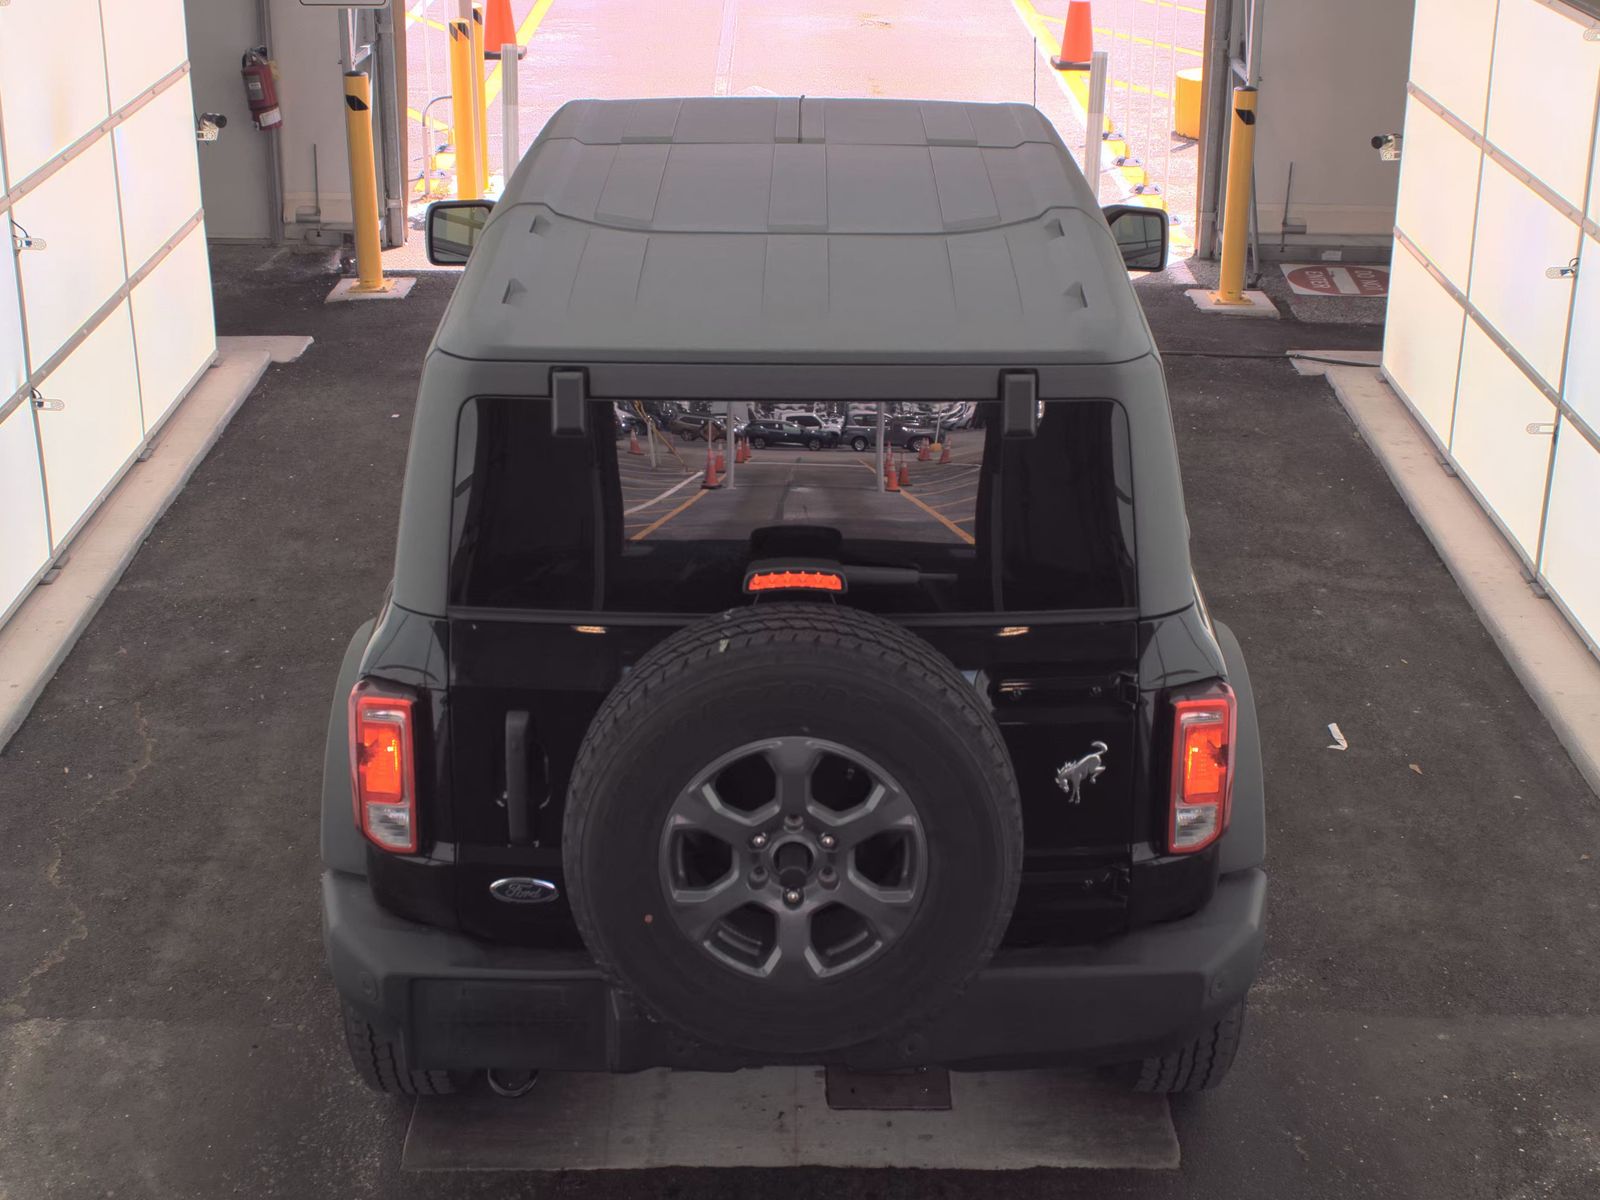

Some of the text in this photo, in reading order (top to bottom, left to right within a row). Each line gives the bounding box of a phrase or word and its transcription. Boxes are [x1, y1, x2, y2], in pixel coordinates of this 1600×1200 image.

[1305, 270, 1331, 289] ENTER
[1355, 270, 1384, 291] DO NOT
[505, 883, 542, 898] Ford
